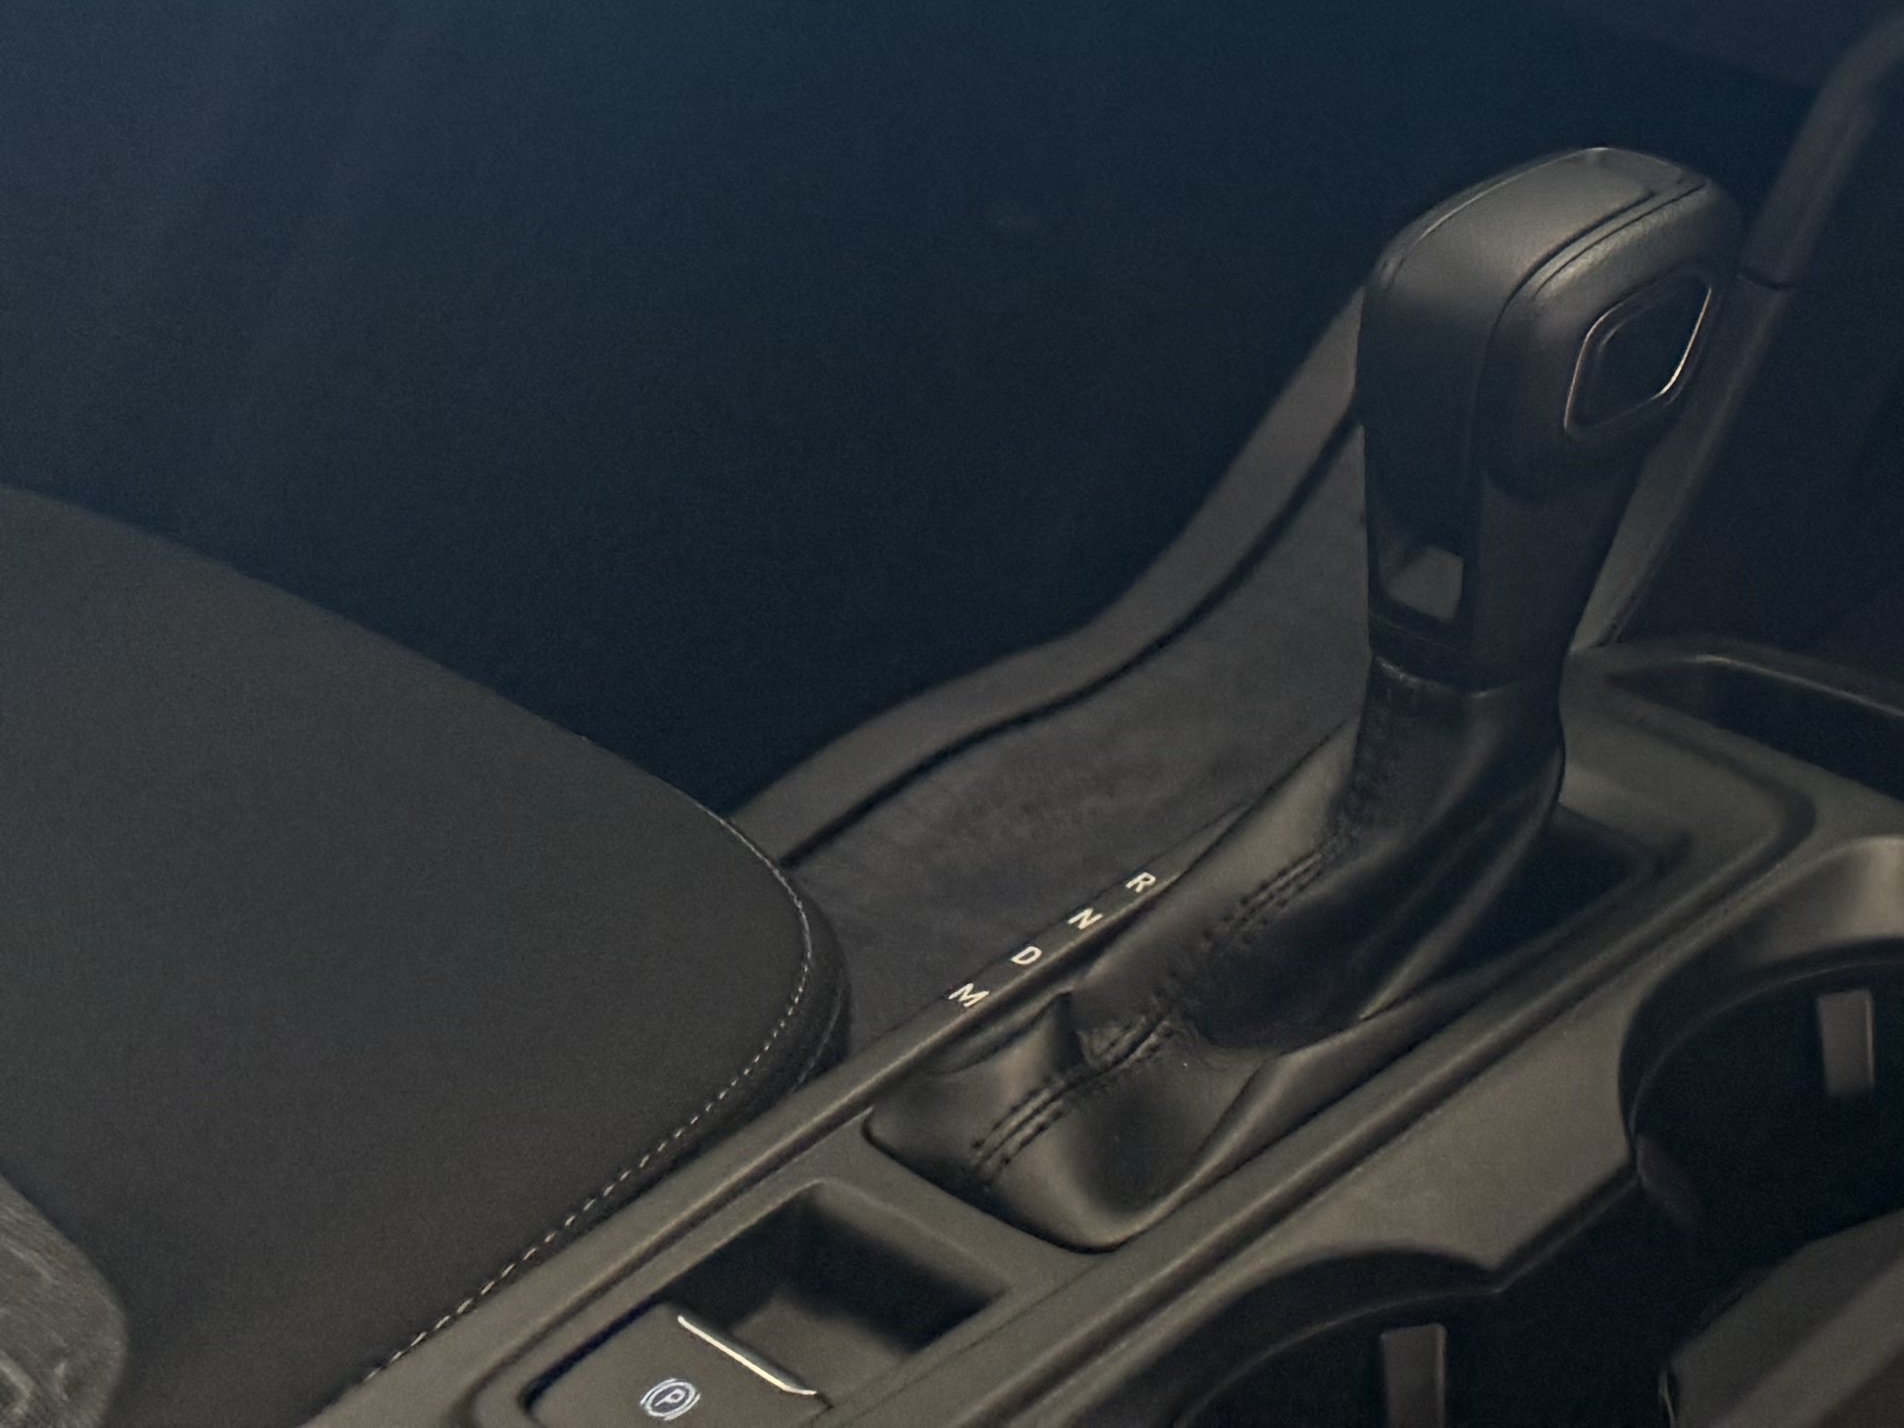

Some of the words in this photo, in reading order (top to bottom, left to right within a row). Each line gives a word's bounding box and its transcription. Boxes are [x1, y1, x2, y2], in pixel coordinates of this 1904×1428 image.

[1125, 871, 1157, 894] R
[1067, 907, 1104, 931] N
[1010, 945, 1043, 966] D
[948, 982, 991, 1009] M
